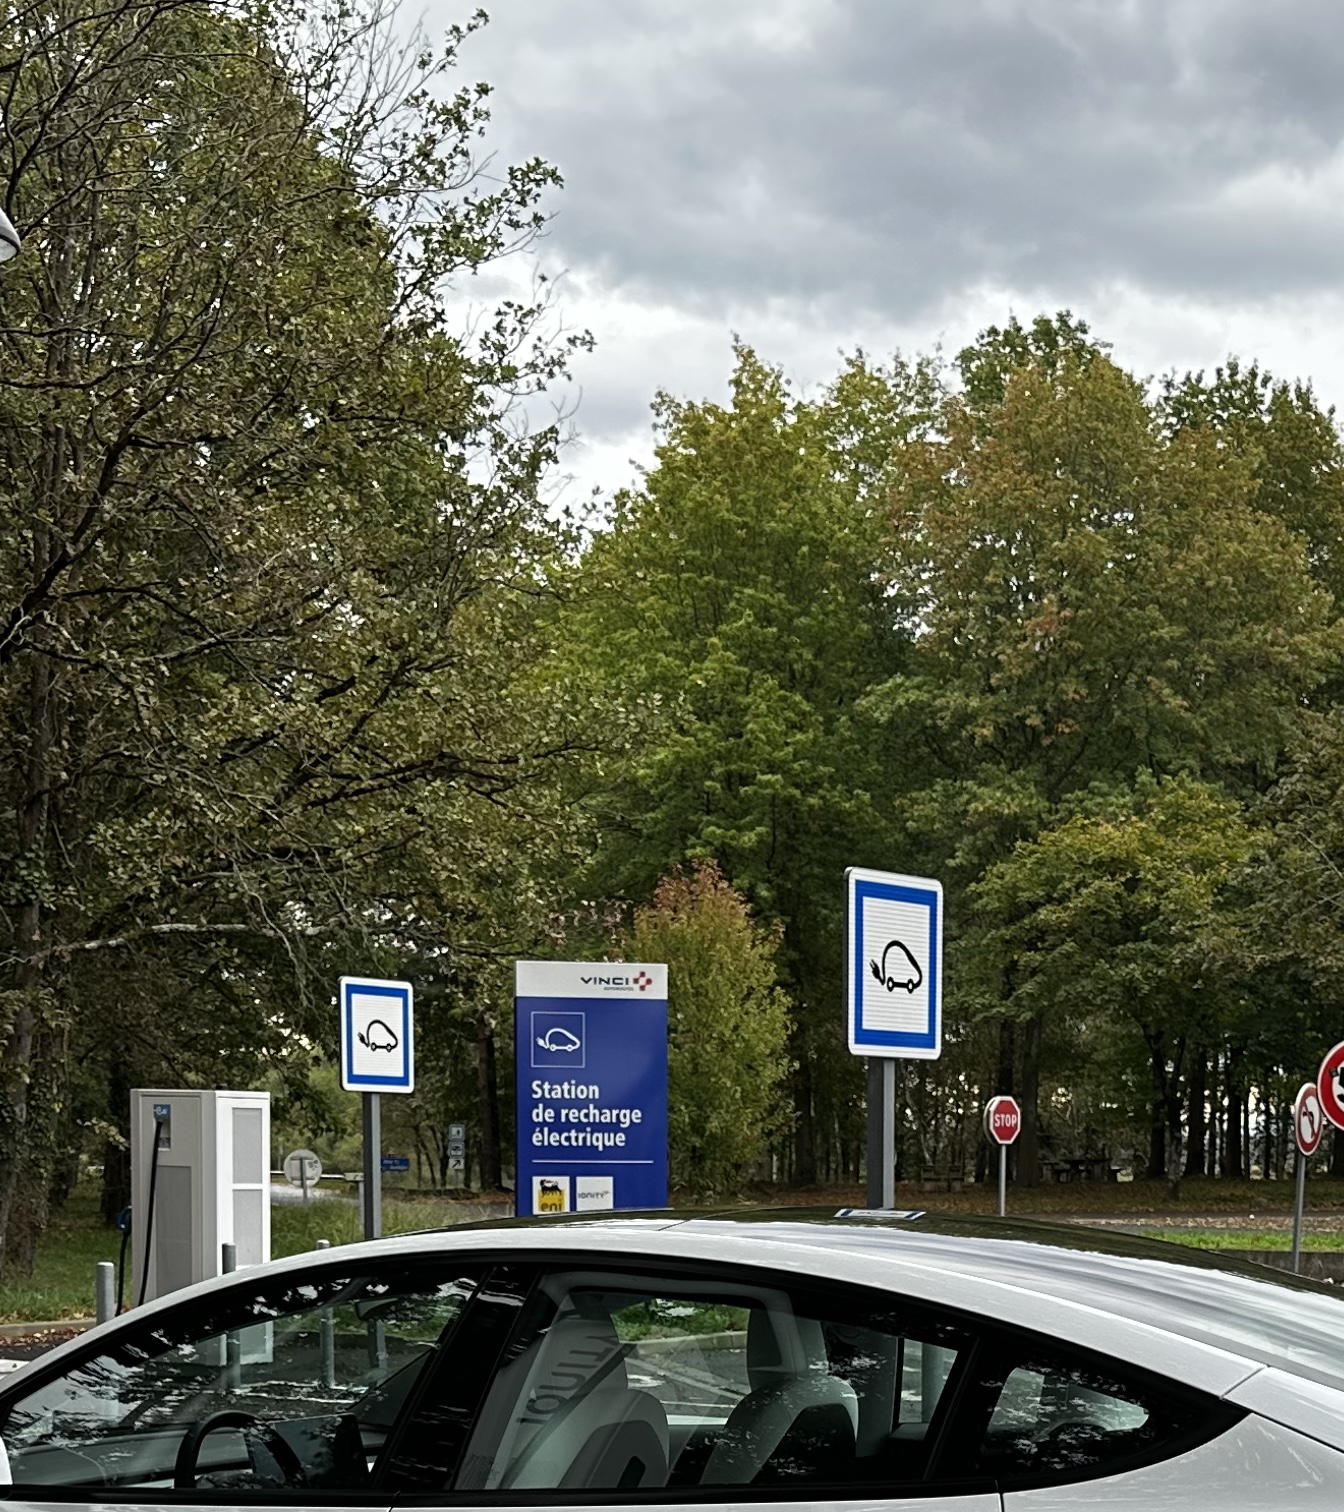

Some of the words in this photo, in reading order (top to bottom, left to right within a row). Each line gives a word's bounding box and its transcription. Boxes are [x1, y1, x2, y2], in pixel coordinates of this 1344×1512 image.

[580, 976, 629, 986] VINCI
[531, 1079, 600, 1100] Station
[531, 1103, 556, 1123] de
[560, 1104, 642, 1129] recharge
[994, 1113, 1017, 1128] STOP
[531, 1126, 626, 1151] électrique
[540, 1202, 562, 1212] eni
